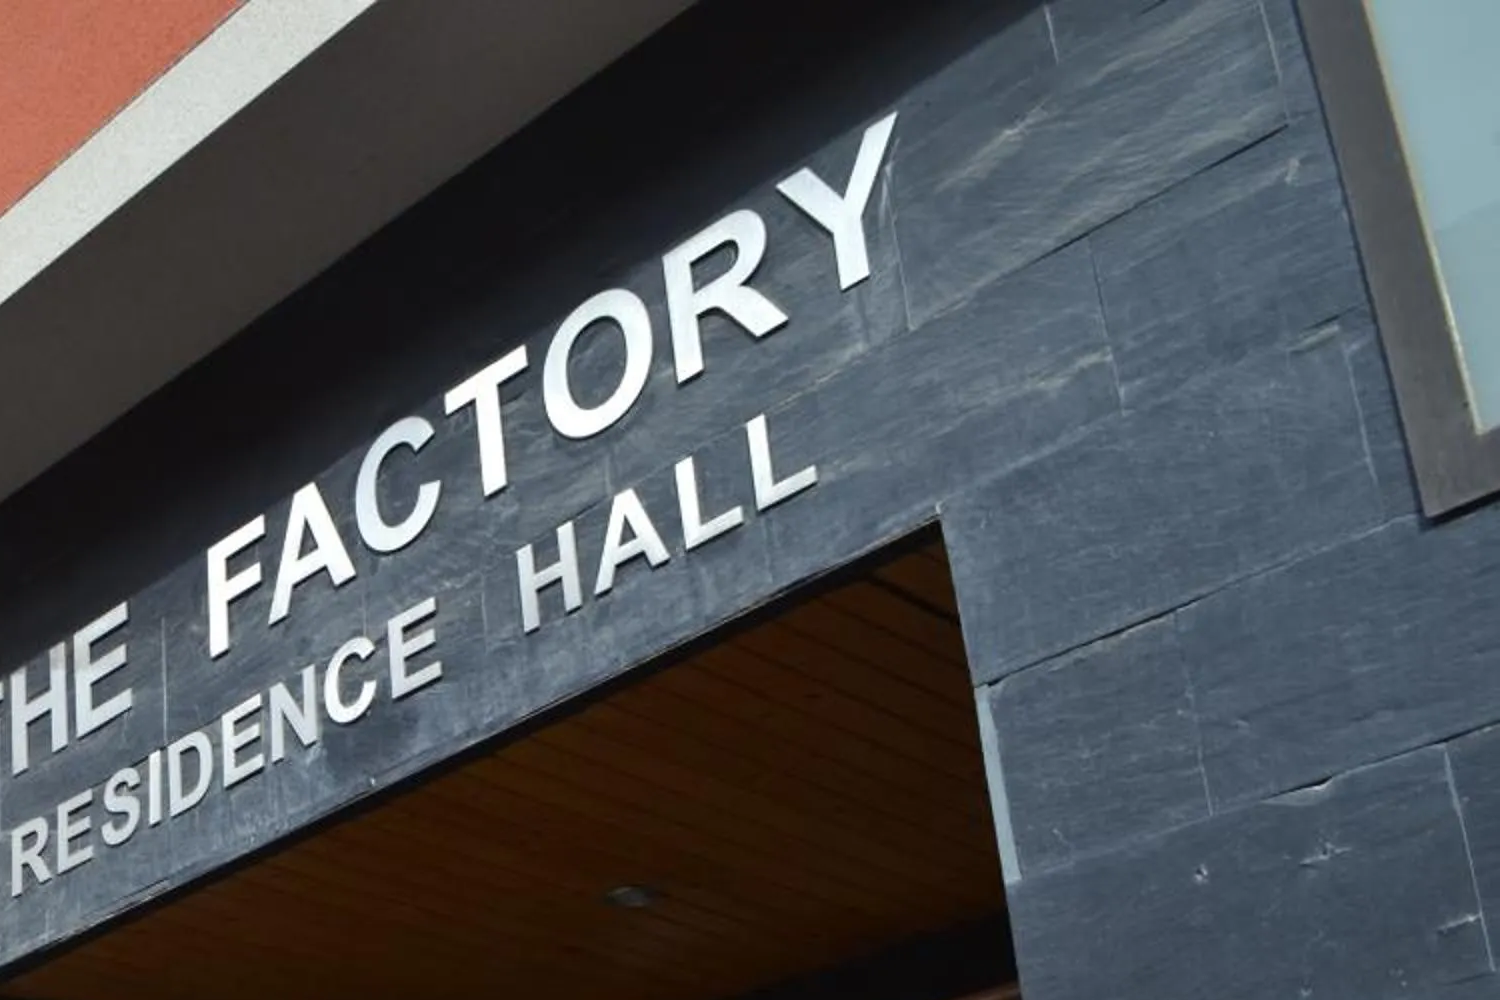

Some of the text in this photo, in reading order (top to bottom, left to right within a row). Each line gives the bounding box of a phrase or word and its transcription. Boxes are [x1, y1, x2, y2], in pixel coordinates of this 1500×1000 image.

[207, 111, 898, 659] FACTORY
[9, 413, 818, 897] RESIDENCE HALL
